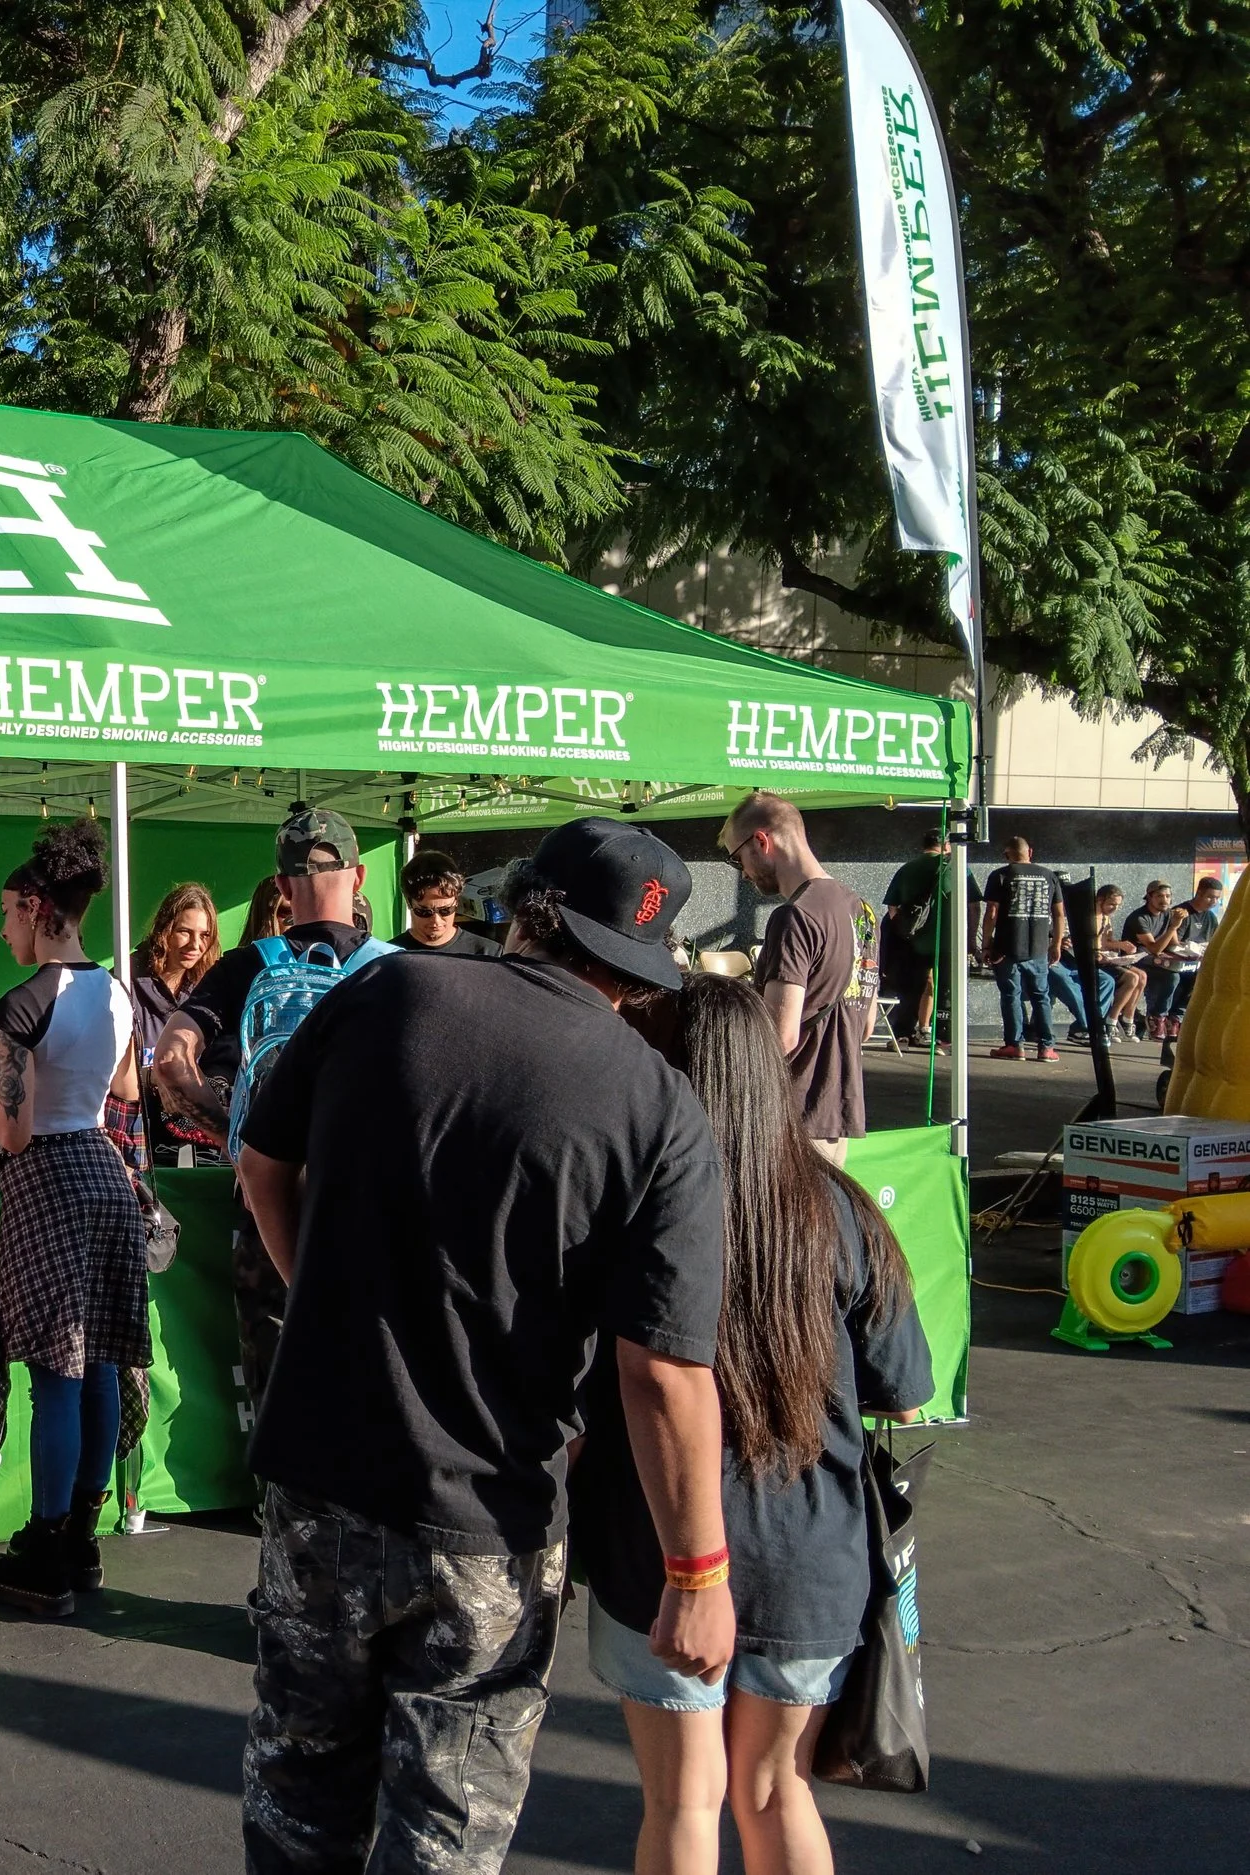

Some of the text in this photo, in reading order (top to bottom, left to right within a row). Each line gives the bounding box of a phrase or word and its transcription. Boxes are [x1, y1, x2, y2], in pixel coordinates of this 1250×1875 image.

[25, 722, 100, 741] DESIGNED
[102, 727, 168, 743] SMOKING
[170, 731, 263, 747] ACCESSOIRES
[378, 739, 631, 762] HIGHLY DESIGNED SMOKING ACCESSOIRES
[728, 757, 945, 781] HIGHLY DESIGNED SMOKING ACCESSOIRES
[1069, 1133, 1181, 1162] GENERAC
[1070, 1194, 1096, 1206] 8125
[1070, 1204, 1096, 1217] 6500
